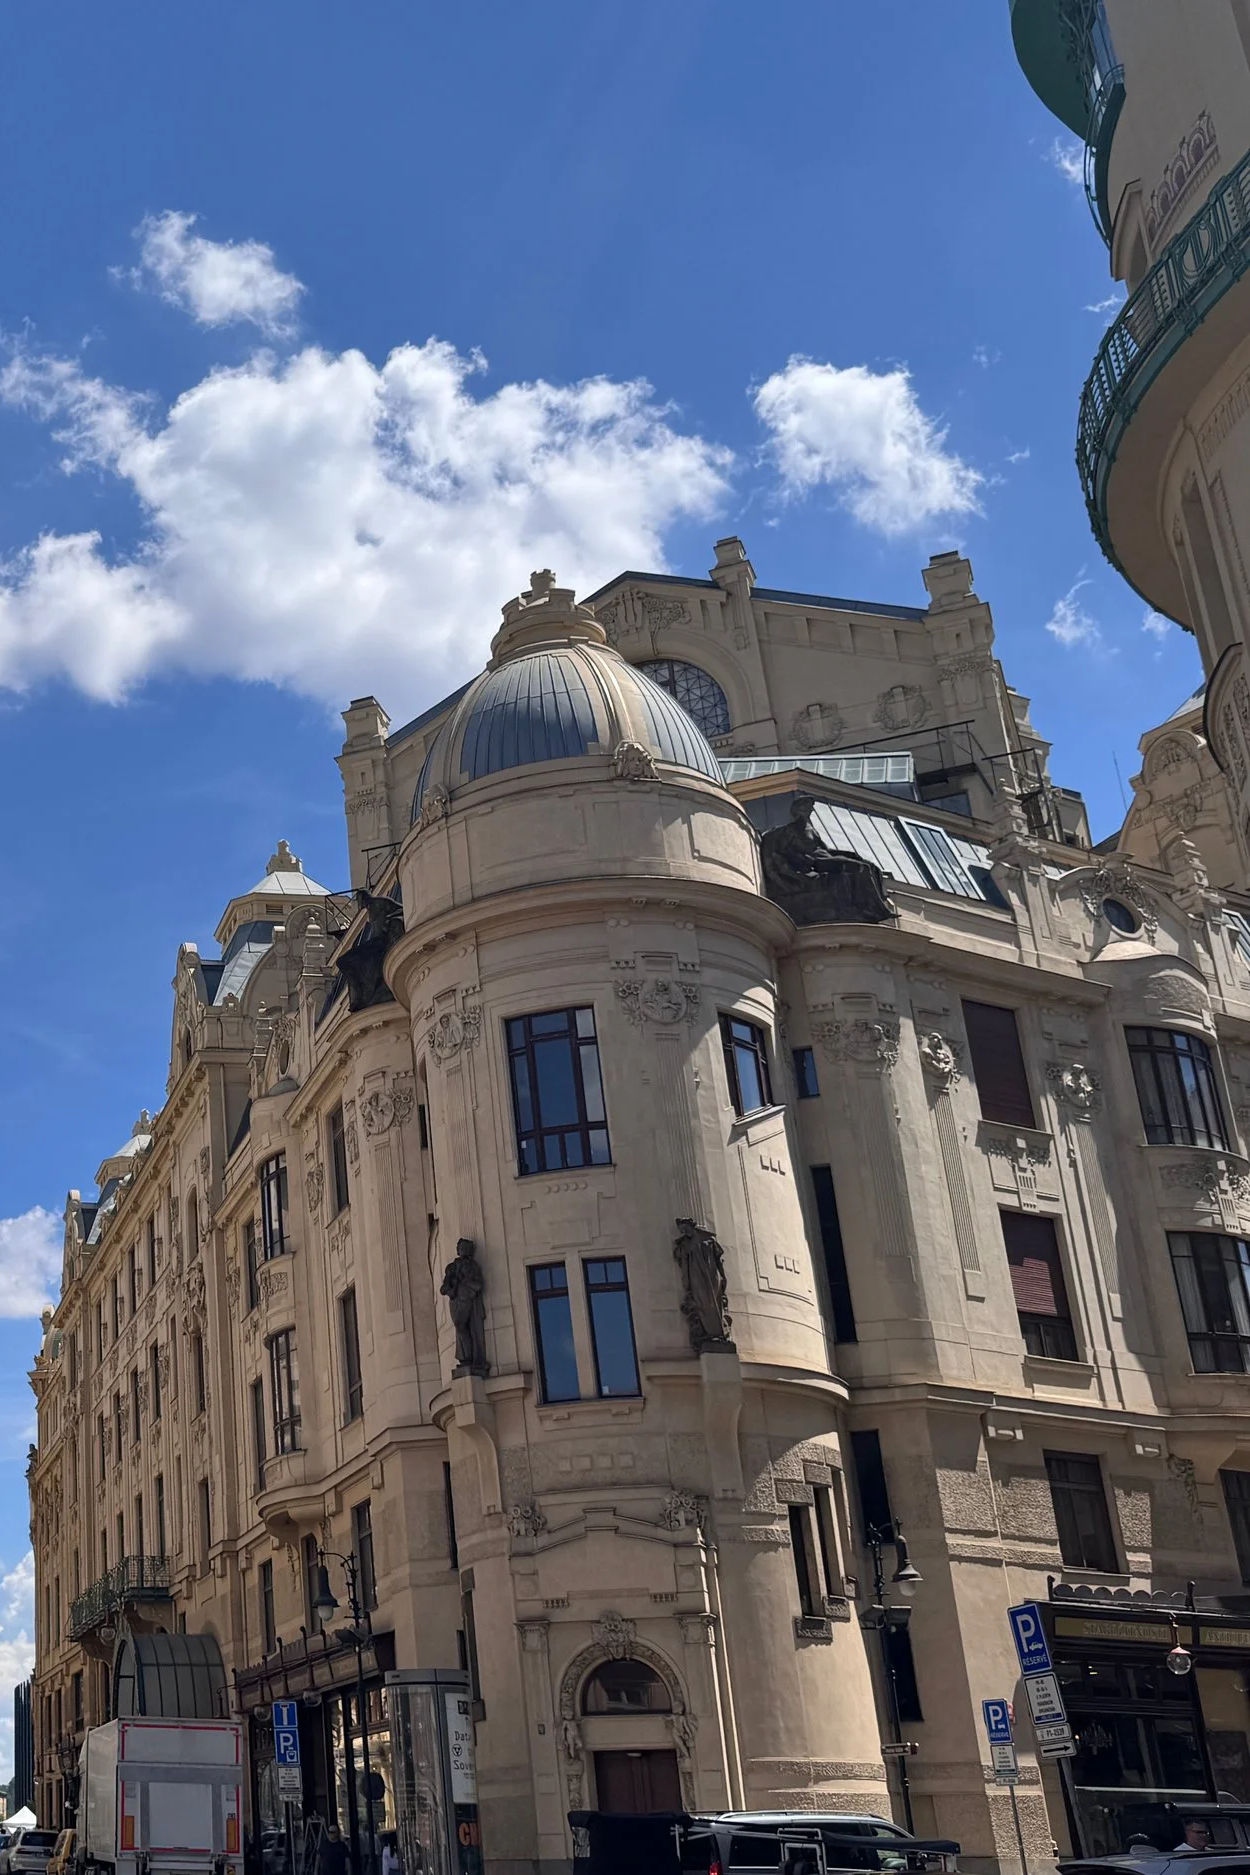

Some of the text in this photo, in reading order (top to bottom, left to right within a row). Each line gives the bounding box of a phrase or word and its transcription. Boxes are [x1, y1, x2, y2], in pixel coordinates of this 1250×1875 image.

[1016, 1614, 1036, 1653] P
[988, 1705, 1003, 1730] P
[279, 1732, 294, 1754] P
